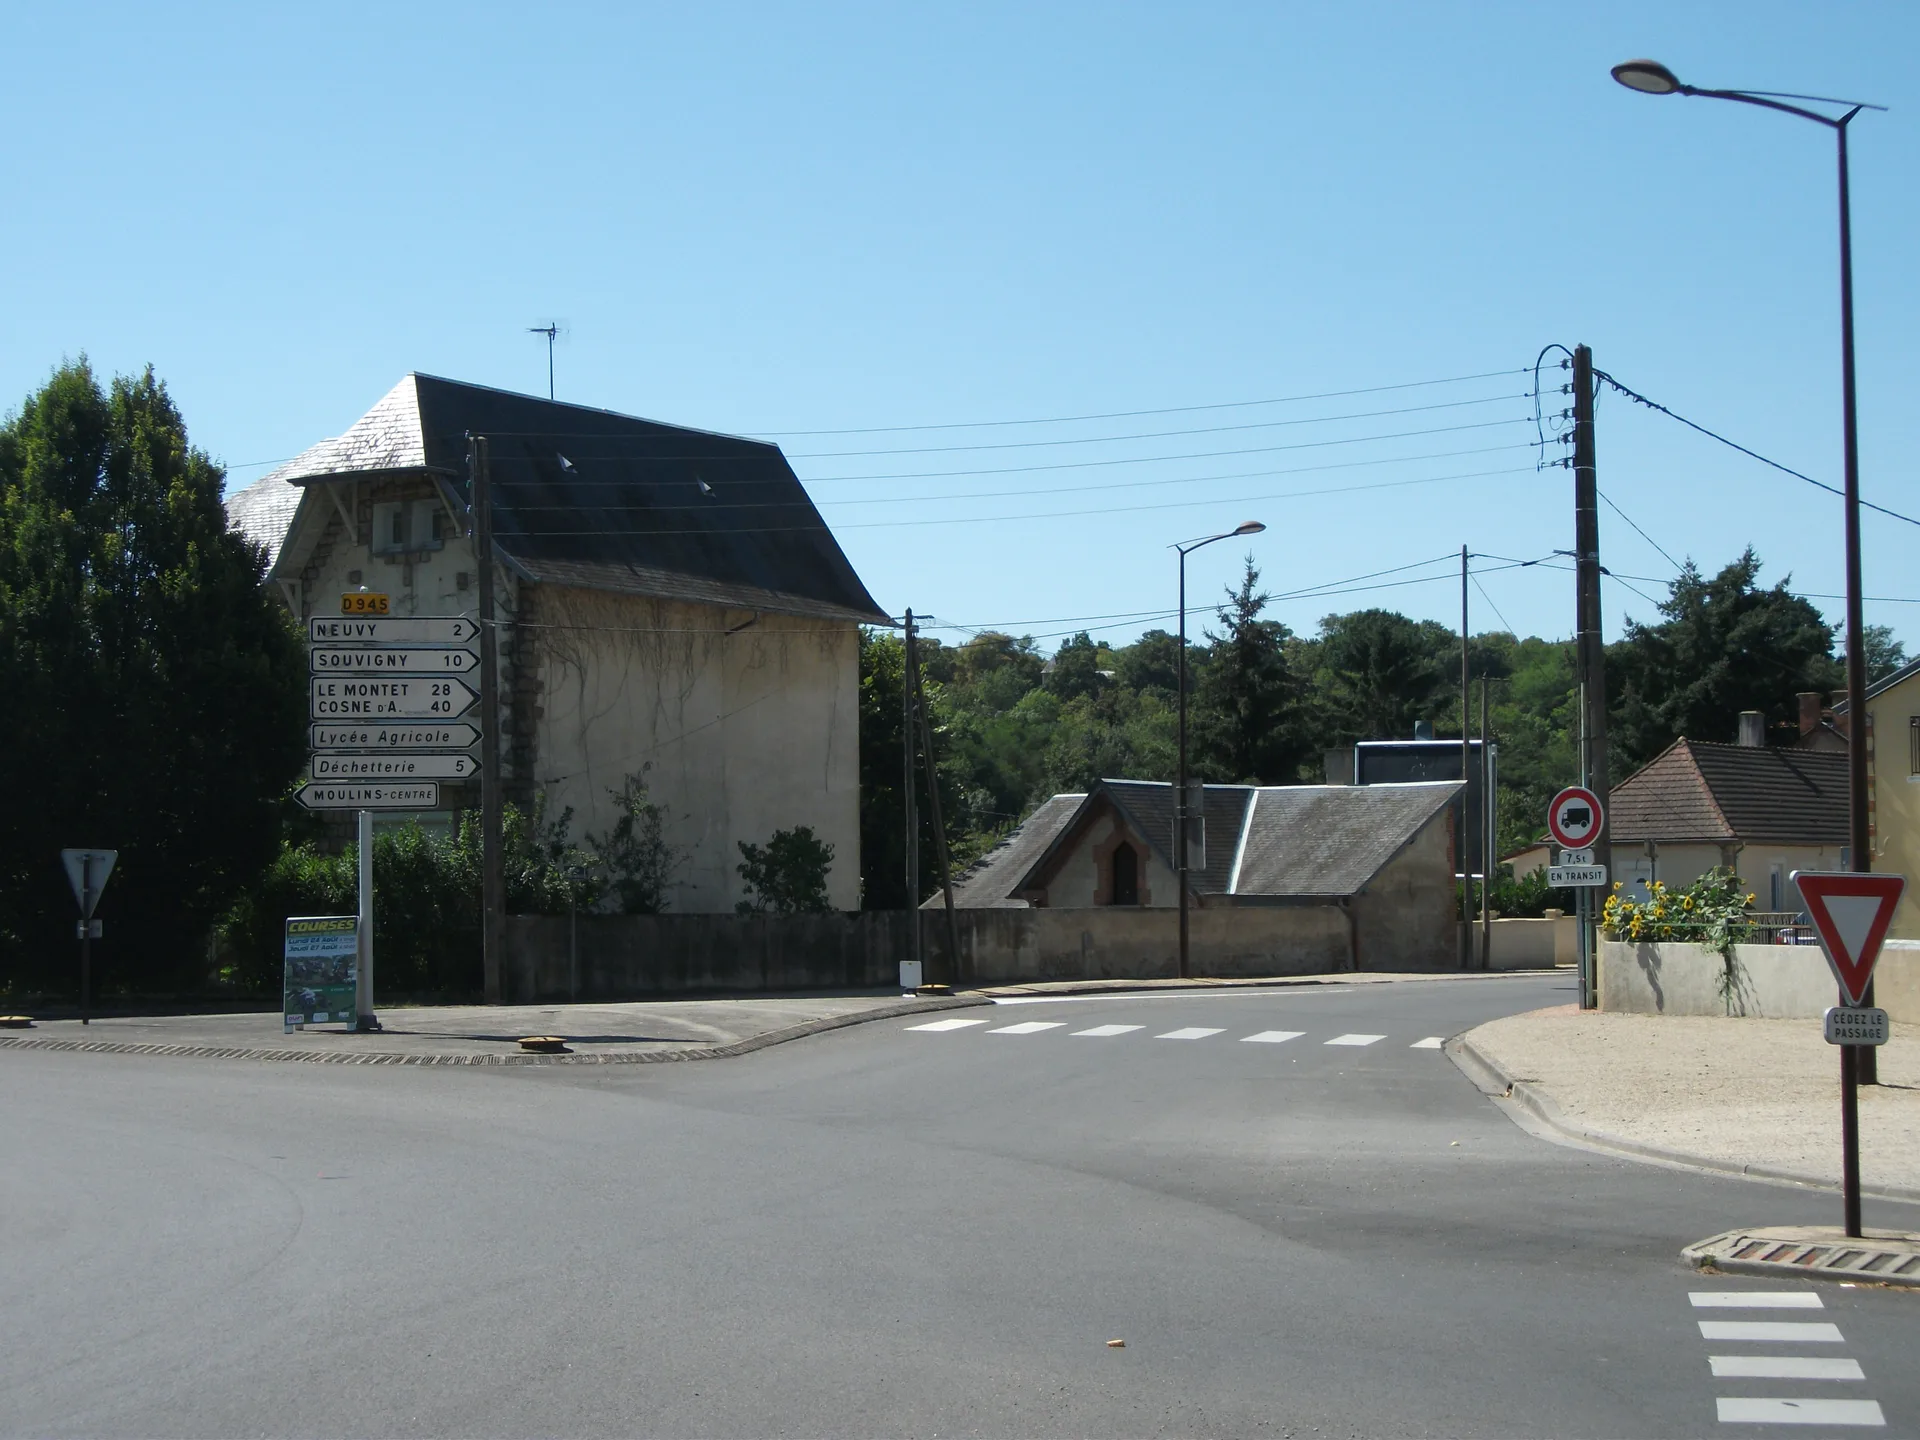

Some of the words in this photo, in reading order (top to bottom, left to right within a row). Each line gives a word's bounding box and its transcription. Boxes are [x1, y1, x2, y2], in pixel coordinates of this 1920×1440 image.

[343, 598, 351, 610] D
[357, 598, 387, 610] 945
[317, 624, 376, 636] NEUVY
[453, 625, 462, 636] 2
[319, 655, 408, 667] SOUVIGNY
[444, 655, 462, 666] 10
[318, 685, 336, 696] LE
[345, 684, 408, 696] MONTET
[432, 684, 451, 695] 28
[319, 701, 371, 713] COSNE
[431, 701, 451, 712] 40
[320, 730, 368, 744] Lycée
[378, 730, 450, 745] Agricole
[320, 760, 414, 773] Déchetterie
[456, 761, 464, 772] 5
[1552, 872, 1562, 881] EN
[1566, 871, 1602, 880] TRANSIT
[289, 920, 355, 932] COURSES
[1834, 1012, 1866, 1024] CÉDEZ
[1871, 1015, 1882, 1025] LE
[1835, 1028, 1881, 1038] PASSAGE
